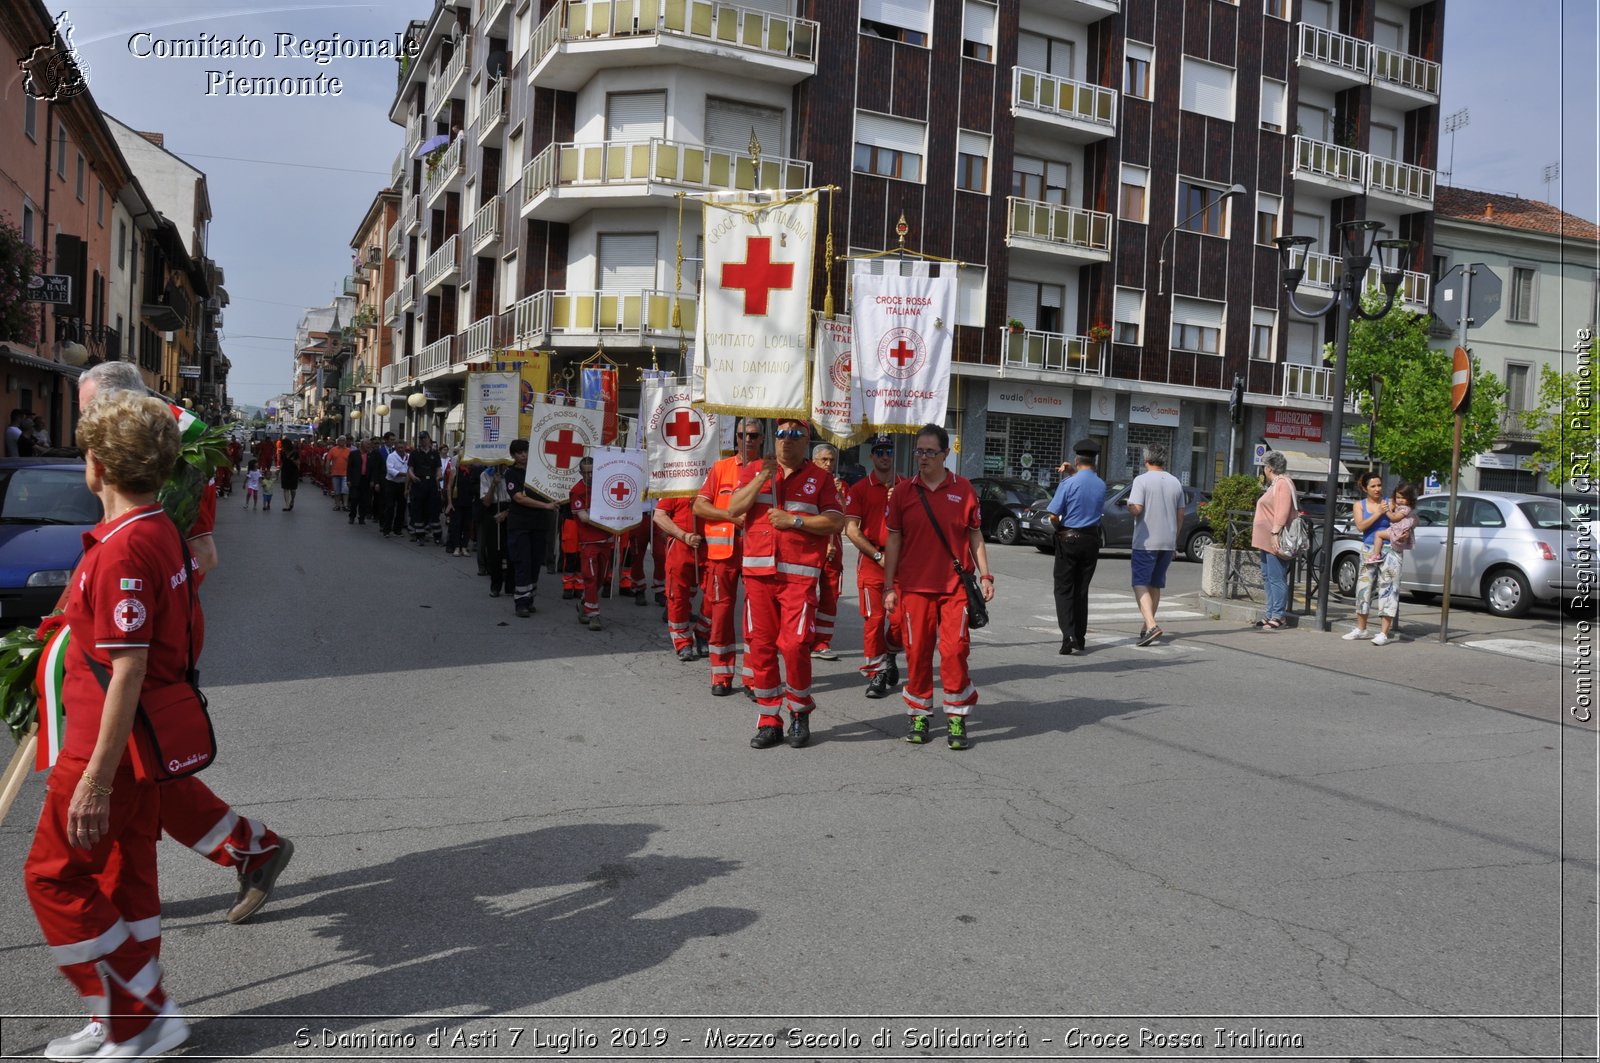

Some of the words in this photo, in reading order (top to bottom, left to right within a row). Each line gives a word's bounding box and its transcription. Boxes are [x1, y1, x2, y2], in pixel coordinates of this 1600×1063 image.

[708, 214, 736, 244] CROCE
[773, 210, 808, 240] ITALIANA
[47, 284, 67, 292] BAR
[876, 296, 902, 304] CROCE
[906, 296, 932, 305] ROSSA
[886, 307, 921, 316] ITALIANA
[706, 333, 754, 348] COMITATO
[764, 335, 805, 349] LOCALE
[713, 358, 734, 372] SAN
[743, 360, 790, 374] DAMIANO
[732, 385, 766, 399] D'ASTI
[866, 390, 901, 398] COMITATO
[904, 390, 934, 399] LOCALE
[1000, 393, 1023, 402] audio
[1033, 396, 1062, 405] sanitas
[650, 404, 666, 430] CROCE
[664, 393, 690, 406] ROSSA
[1132, 405, 1150, 413] audio
[1157, 407, 1178, 415] sanitas
[1275, 411, 1312, 426] MAGAZINE
[533, 413, 553, 433] CROCE
[579, 414, 599, 442] ITALIANA
[547, 474, 576, 482] COMITATO
[652, 468, 698, 479] MONTEGROSSO
[532, 477, 566, 498] VILLANOVA
